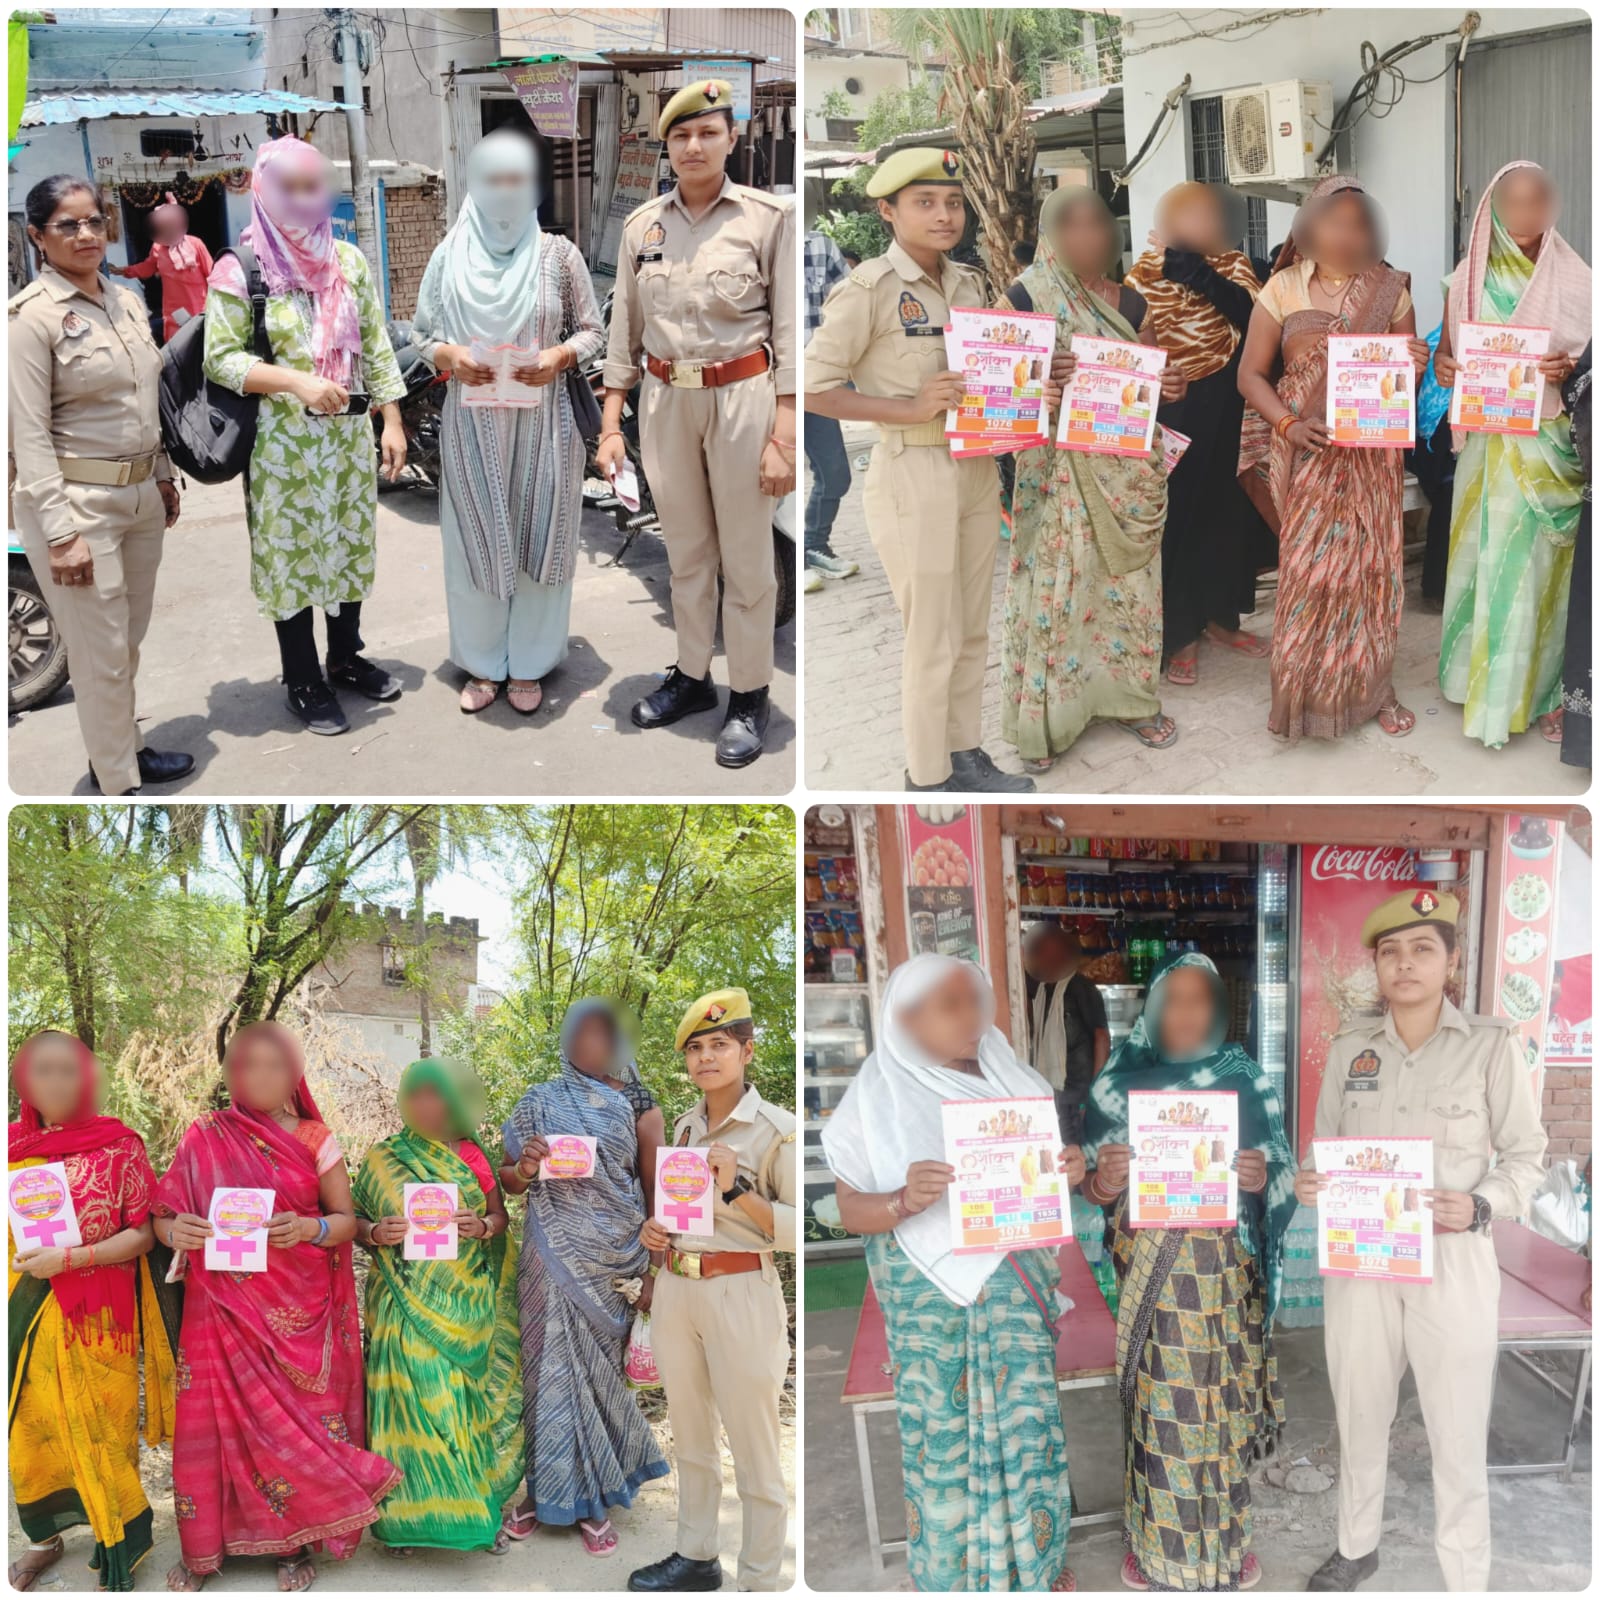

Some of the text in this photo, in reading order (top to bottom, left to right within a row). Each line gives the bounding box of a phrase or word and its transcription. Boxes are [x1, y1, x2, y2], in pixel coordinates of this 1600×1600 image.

[987, 420, 1013, 428] 1076
[1310, 844, 1416, 881] Coca-Cola
[1170, 1206, 1198, 1215] 1076
[1000, 1225, 1030, 1237] 1076
[1360, 1256, 1389, 1267] 1076
